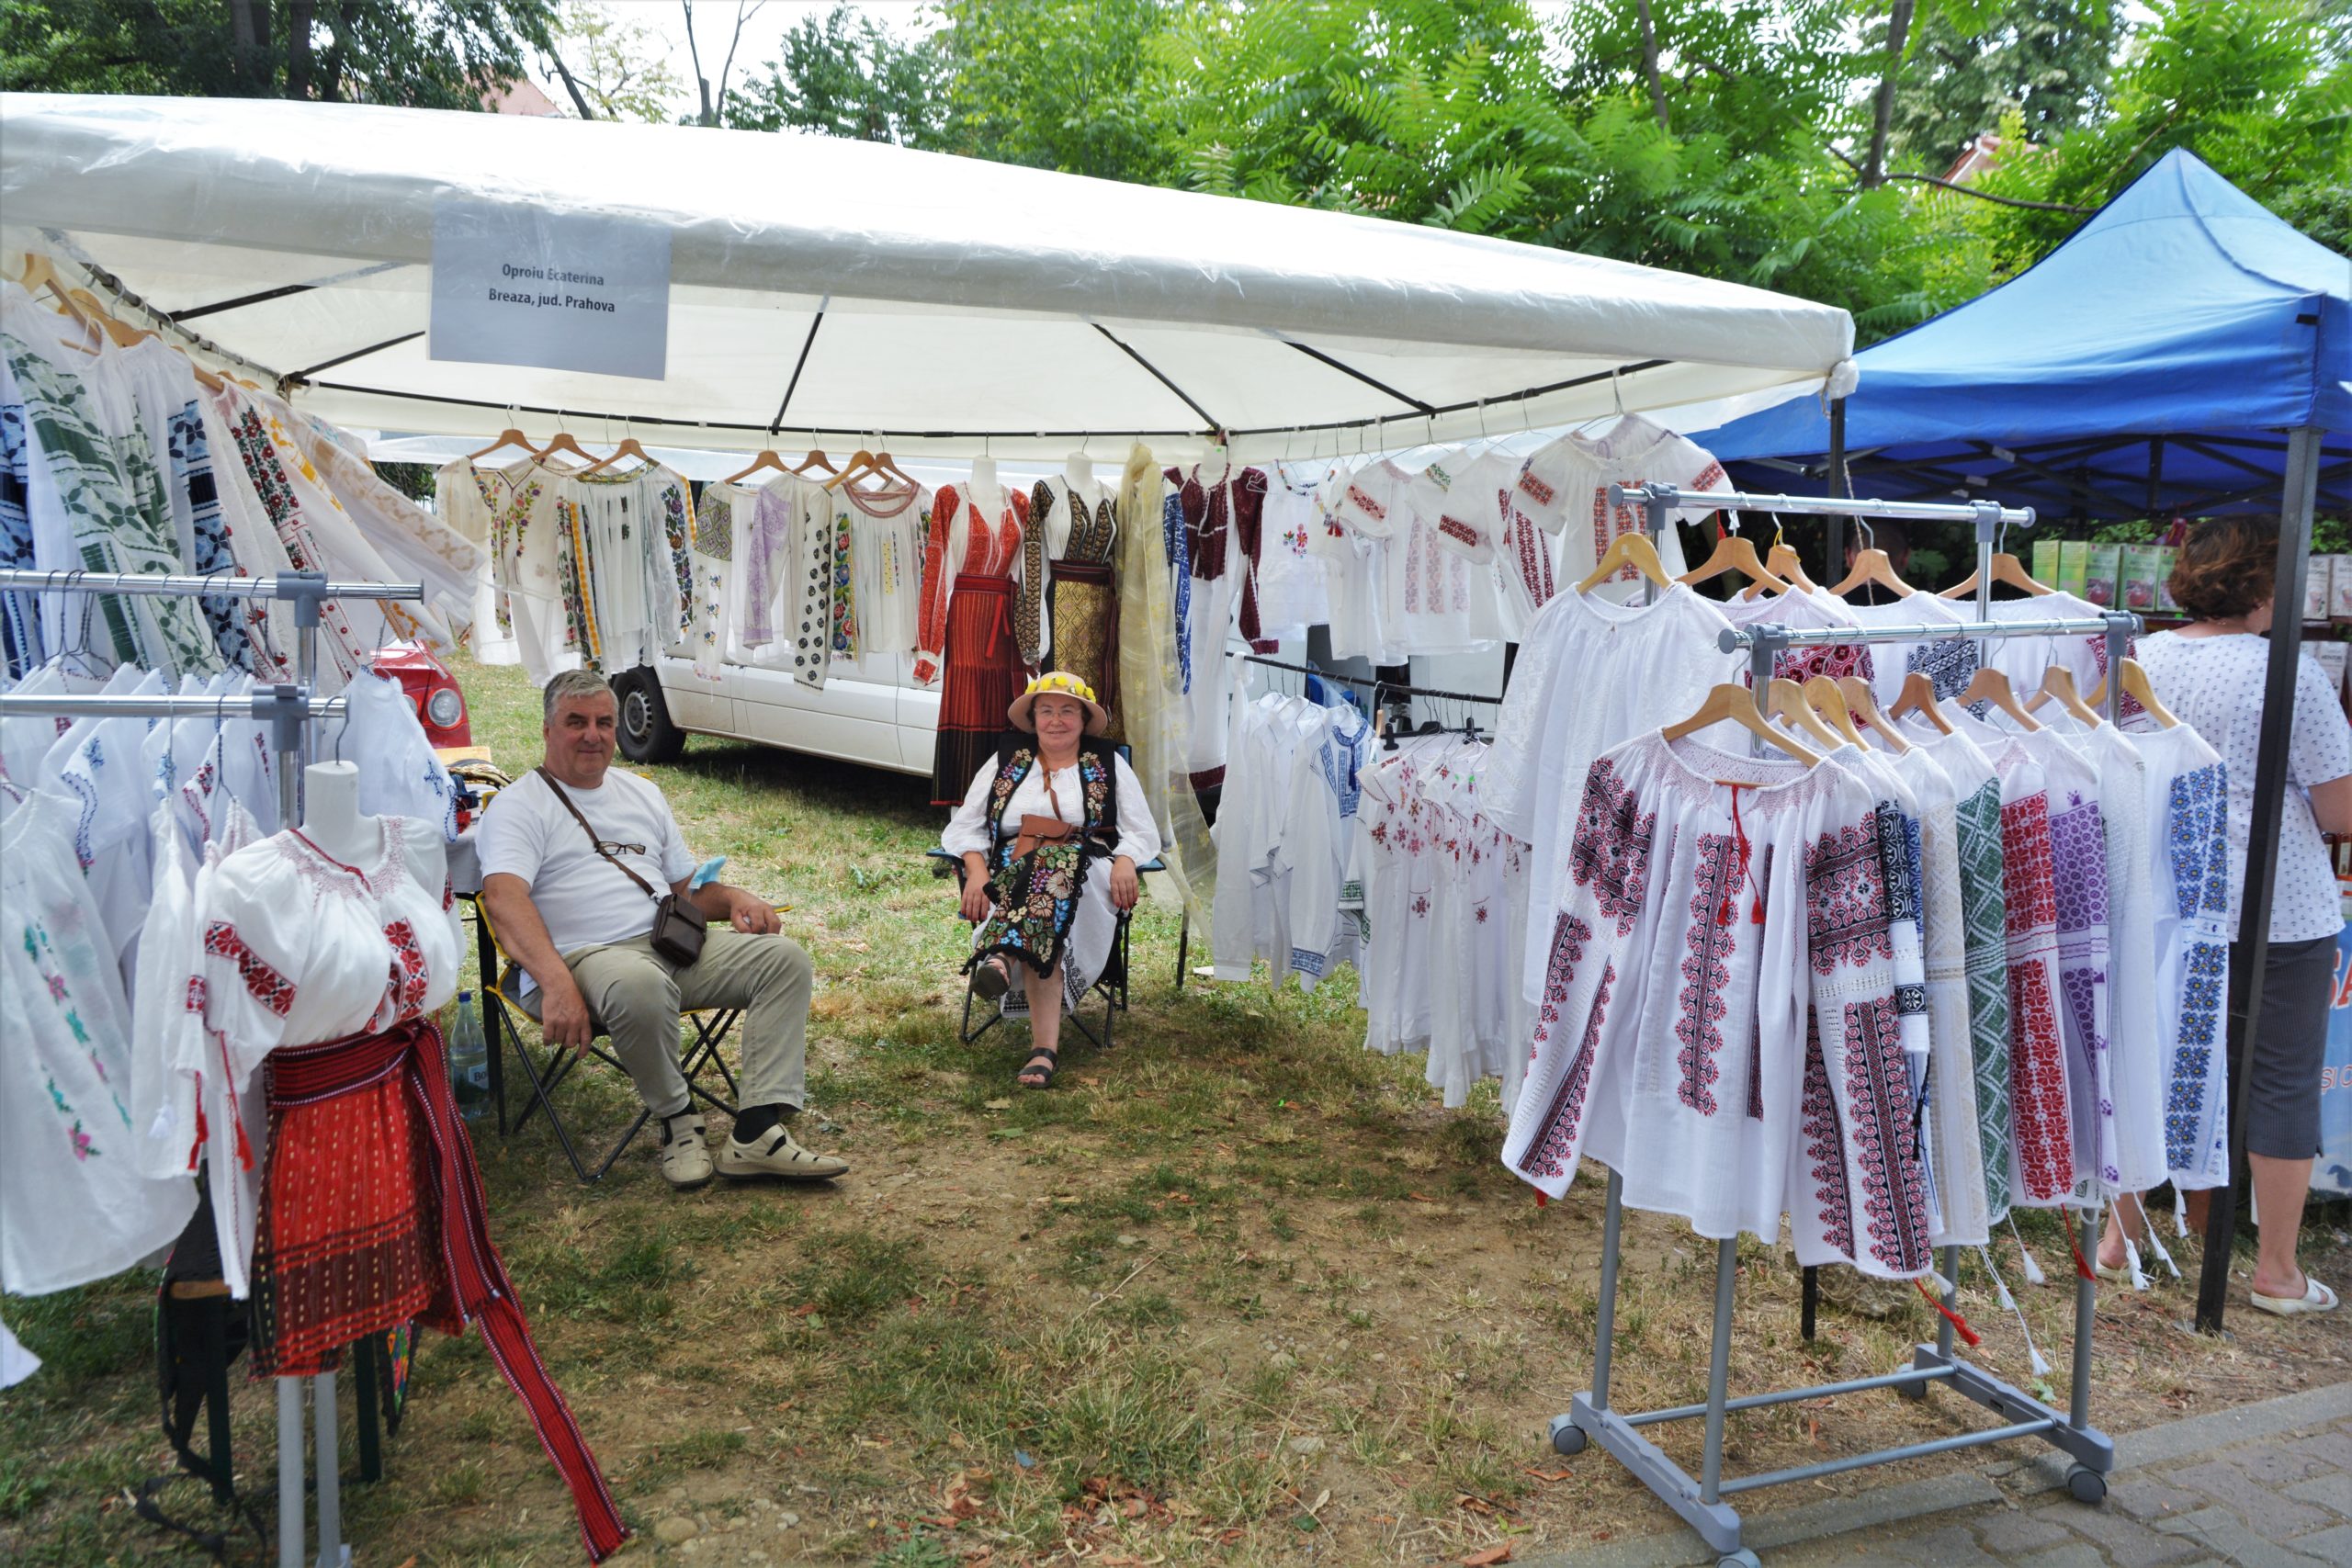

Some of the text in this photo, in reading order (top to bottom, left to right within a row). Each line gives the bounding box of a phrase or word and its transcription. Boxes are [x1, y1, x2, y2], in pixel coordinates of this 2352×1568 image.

[503, 264, 605, 286] Oproiu Ecaterina
[489, 288, 615, 312] Breaza, jud. Prahova
